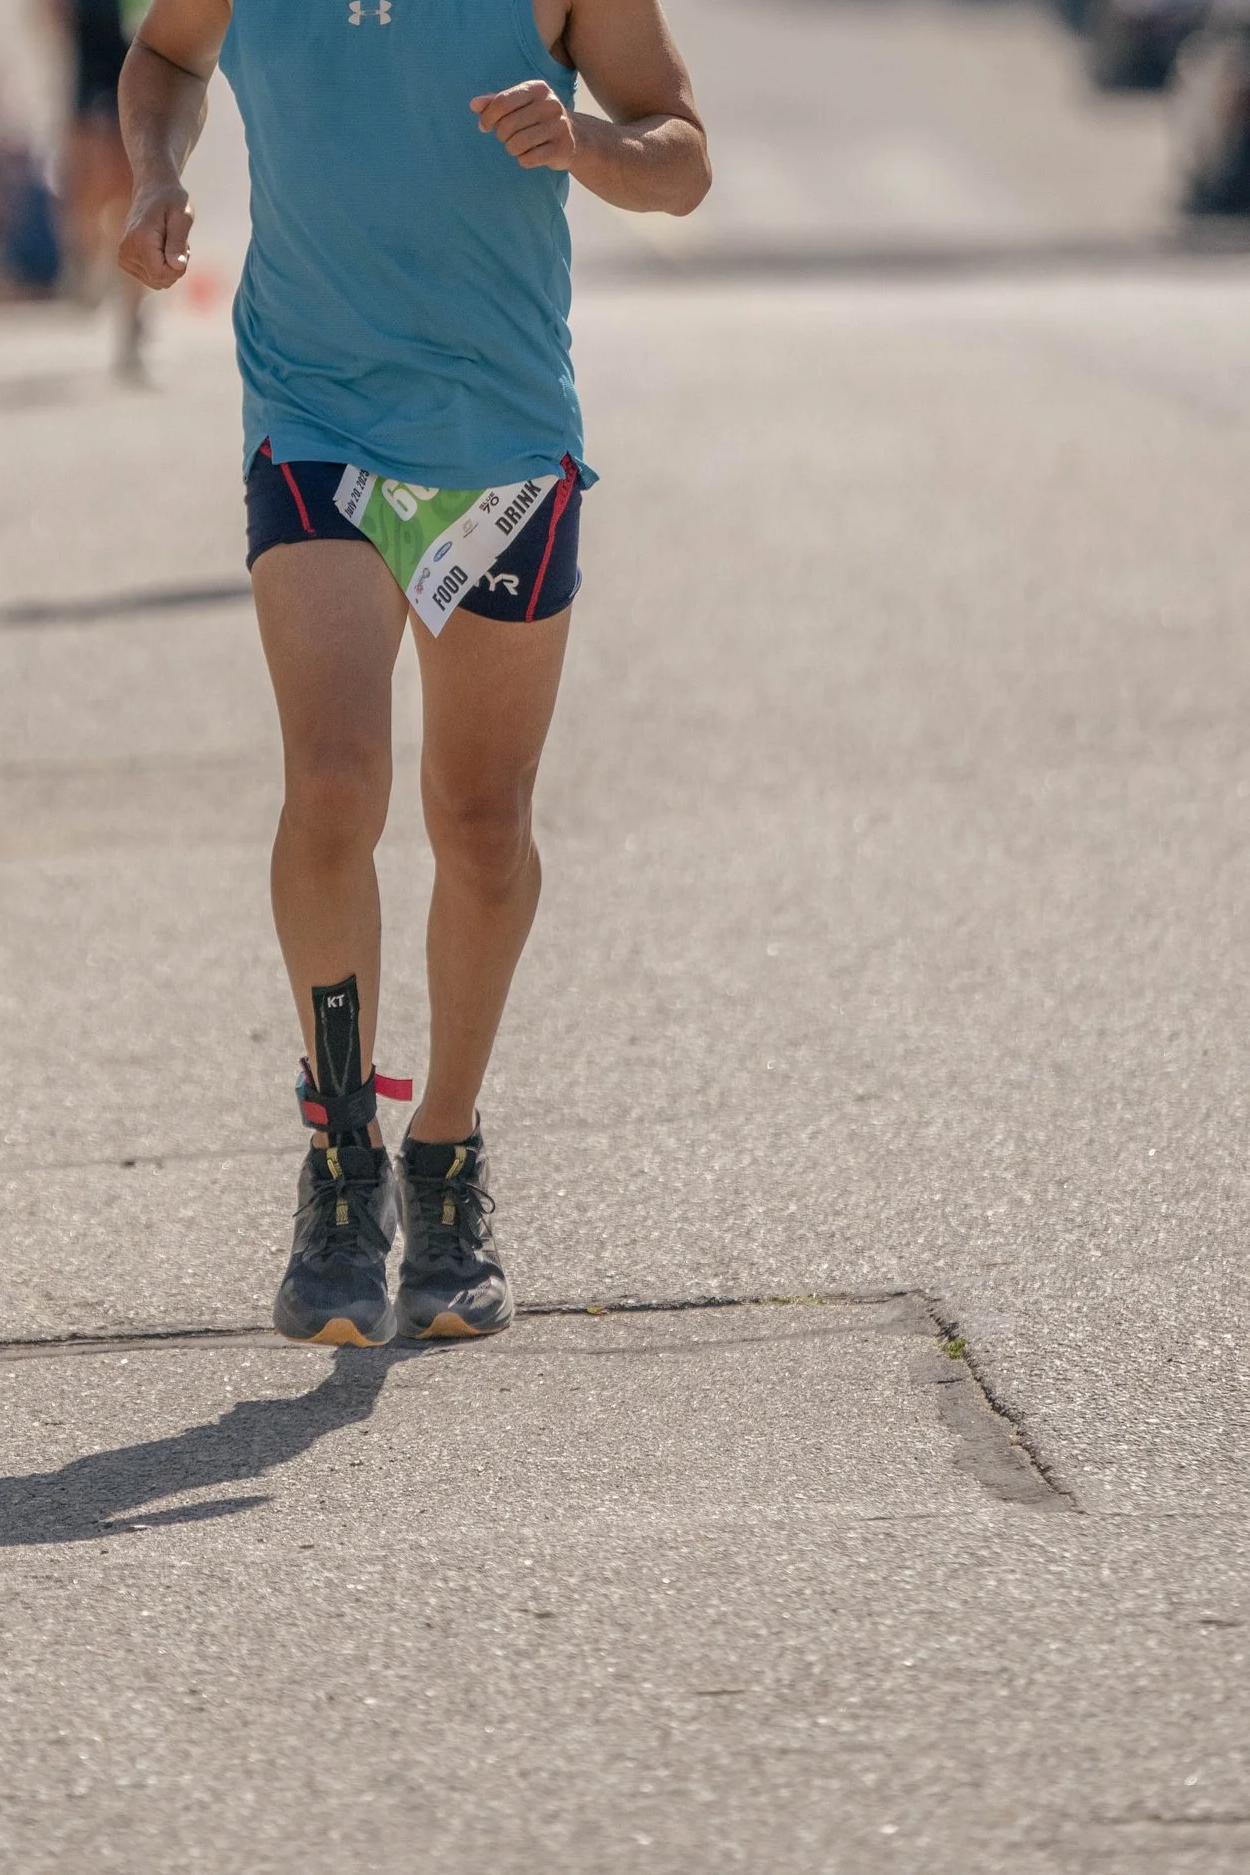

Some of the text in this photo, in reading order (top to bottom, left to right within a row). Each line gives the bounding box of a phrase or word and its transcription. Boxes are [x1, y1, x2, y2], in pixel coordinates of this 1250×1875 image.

[479, 491, 495, 510] BLUE
[482, 496, 499, 514] 70
[494, 480, 541, 536] DRINK
[432, 565, 468, 611] FOOD
[472, 571, 520, 595] YR
[327, 994, 345, 1008] KT
